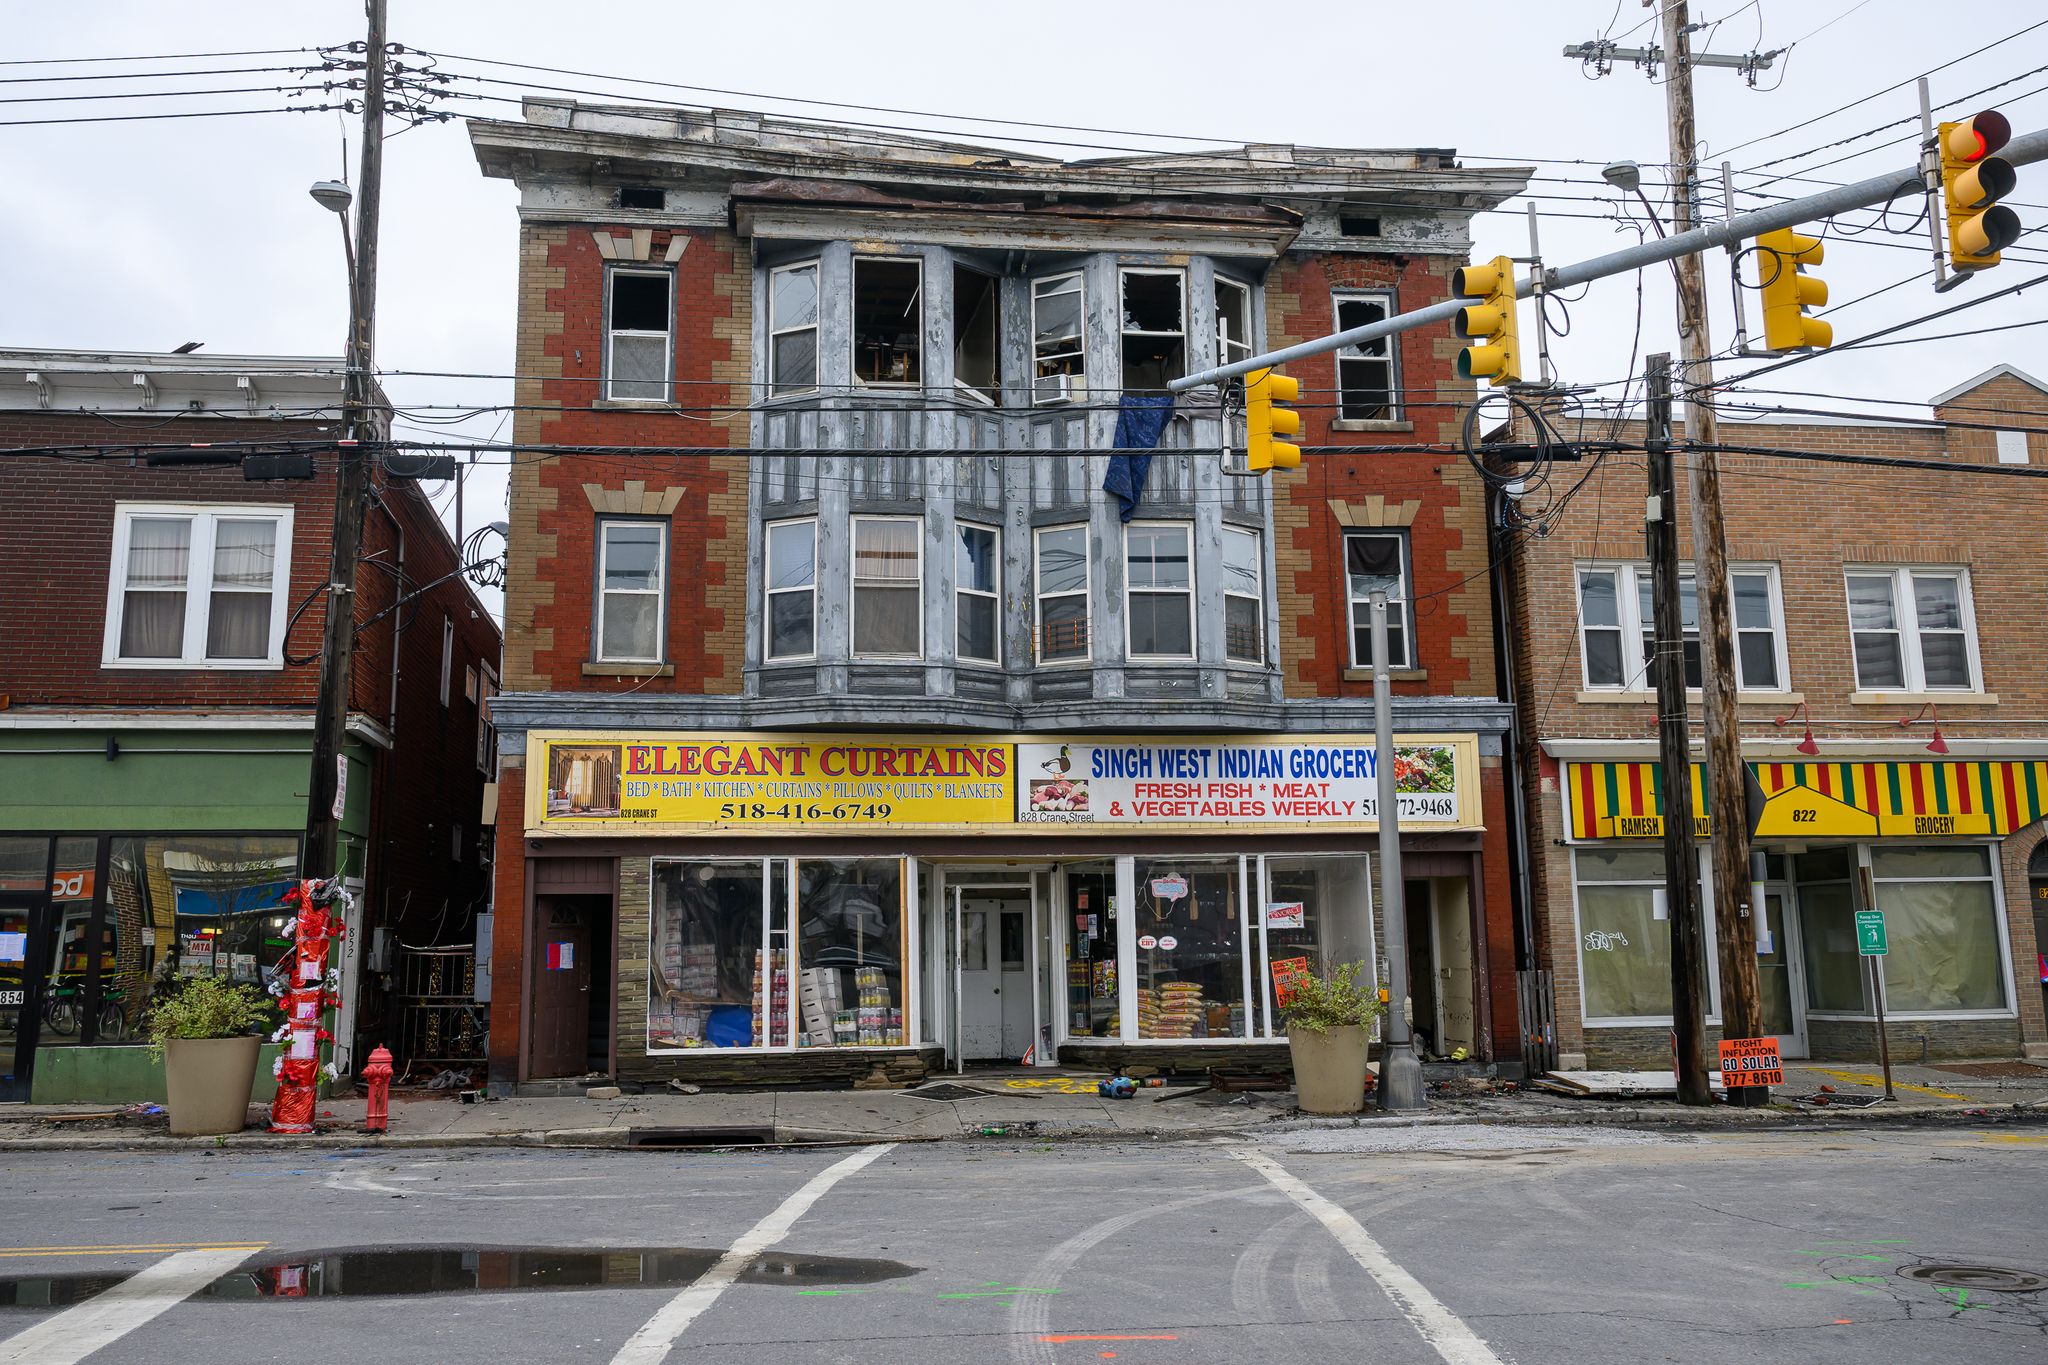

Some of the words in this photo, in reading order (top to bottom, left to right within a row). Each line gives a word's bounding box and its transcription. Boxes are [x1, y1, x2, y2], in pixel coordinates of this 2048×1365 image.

[626, 746, 810, 777] ELEGANT
[819, 747, 1007, 778] CURTAINS
[1092, 748, 1152, 779] SINGH
[1158, 749, 1212, 779] WEST
[1218, 749, 1284, 779] INDIAN
[1289, 749, 1378, 779] GROCERY
[626, 781, 651, 798] BED
[661, 782, 692, 798] BATH
[703, 782, 755, 798] KITCHEN
[765, 782, 822, 799] CURTAINS
[833, 782, 883, 799] PILLOWS
[893, 783, 934, 801] QUILTS
[944, 783, 1003, 799] BLANKETS
[1135, 783, 1201, 798] FRESH
[1208, 783, 1253, 798] FISH
[1273, 783, 1330, 798] MEAT
[620, 809, 632, 819] 828
[632, 809, 650, 819] CRANE
[650, 809, 658, 819] ST
[720, 803, 892, 819] 518-416-6749
[1109, 801, 1124, 817] &
[1131, 801, 1266, 817] VEGETABLES
[1272, 801, 1356, 816] WEEKLY
[1362, 798, 1453, 816] 5172-9468
[1020, 813, 1038, 823] 828
[1039, 813, 1066, 823] Crane
[1068, 813, 1095, 823] Street
[1792, 810, 1817, 822] 822
[1621, 818, 1660, 835] RAMESH
[1914, 816, 1955, 834] GROCERY
[1740, 908, 1750, 918] 19
[0, 991, 23, 1004] 854
[1733, 1039, 1763, 1048] FIGHT
[1722, 1046, 1777, 1058] INFLATION
[1722, 1057, 1739, 1071] GO
[1741, 1055, 1779, 1070] SOLAR
[1724, 1071, 1783, 1086] 577-8610
